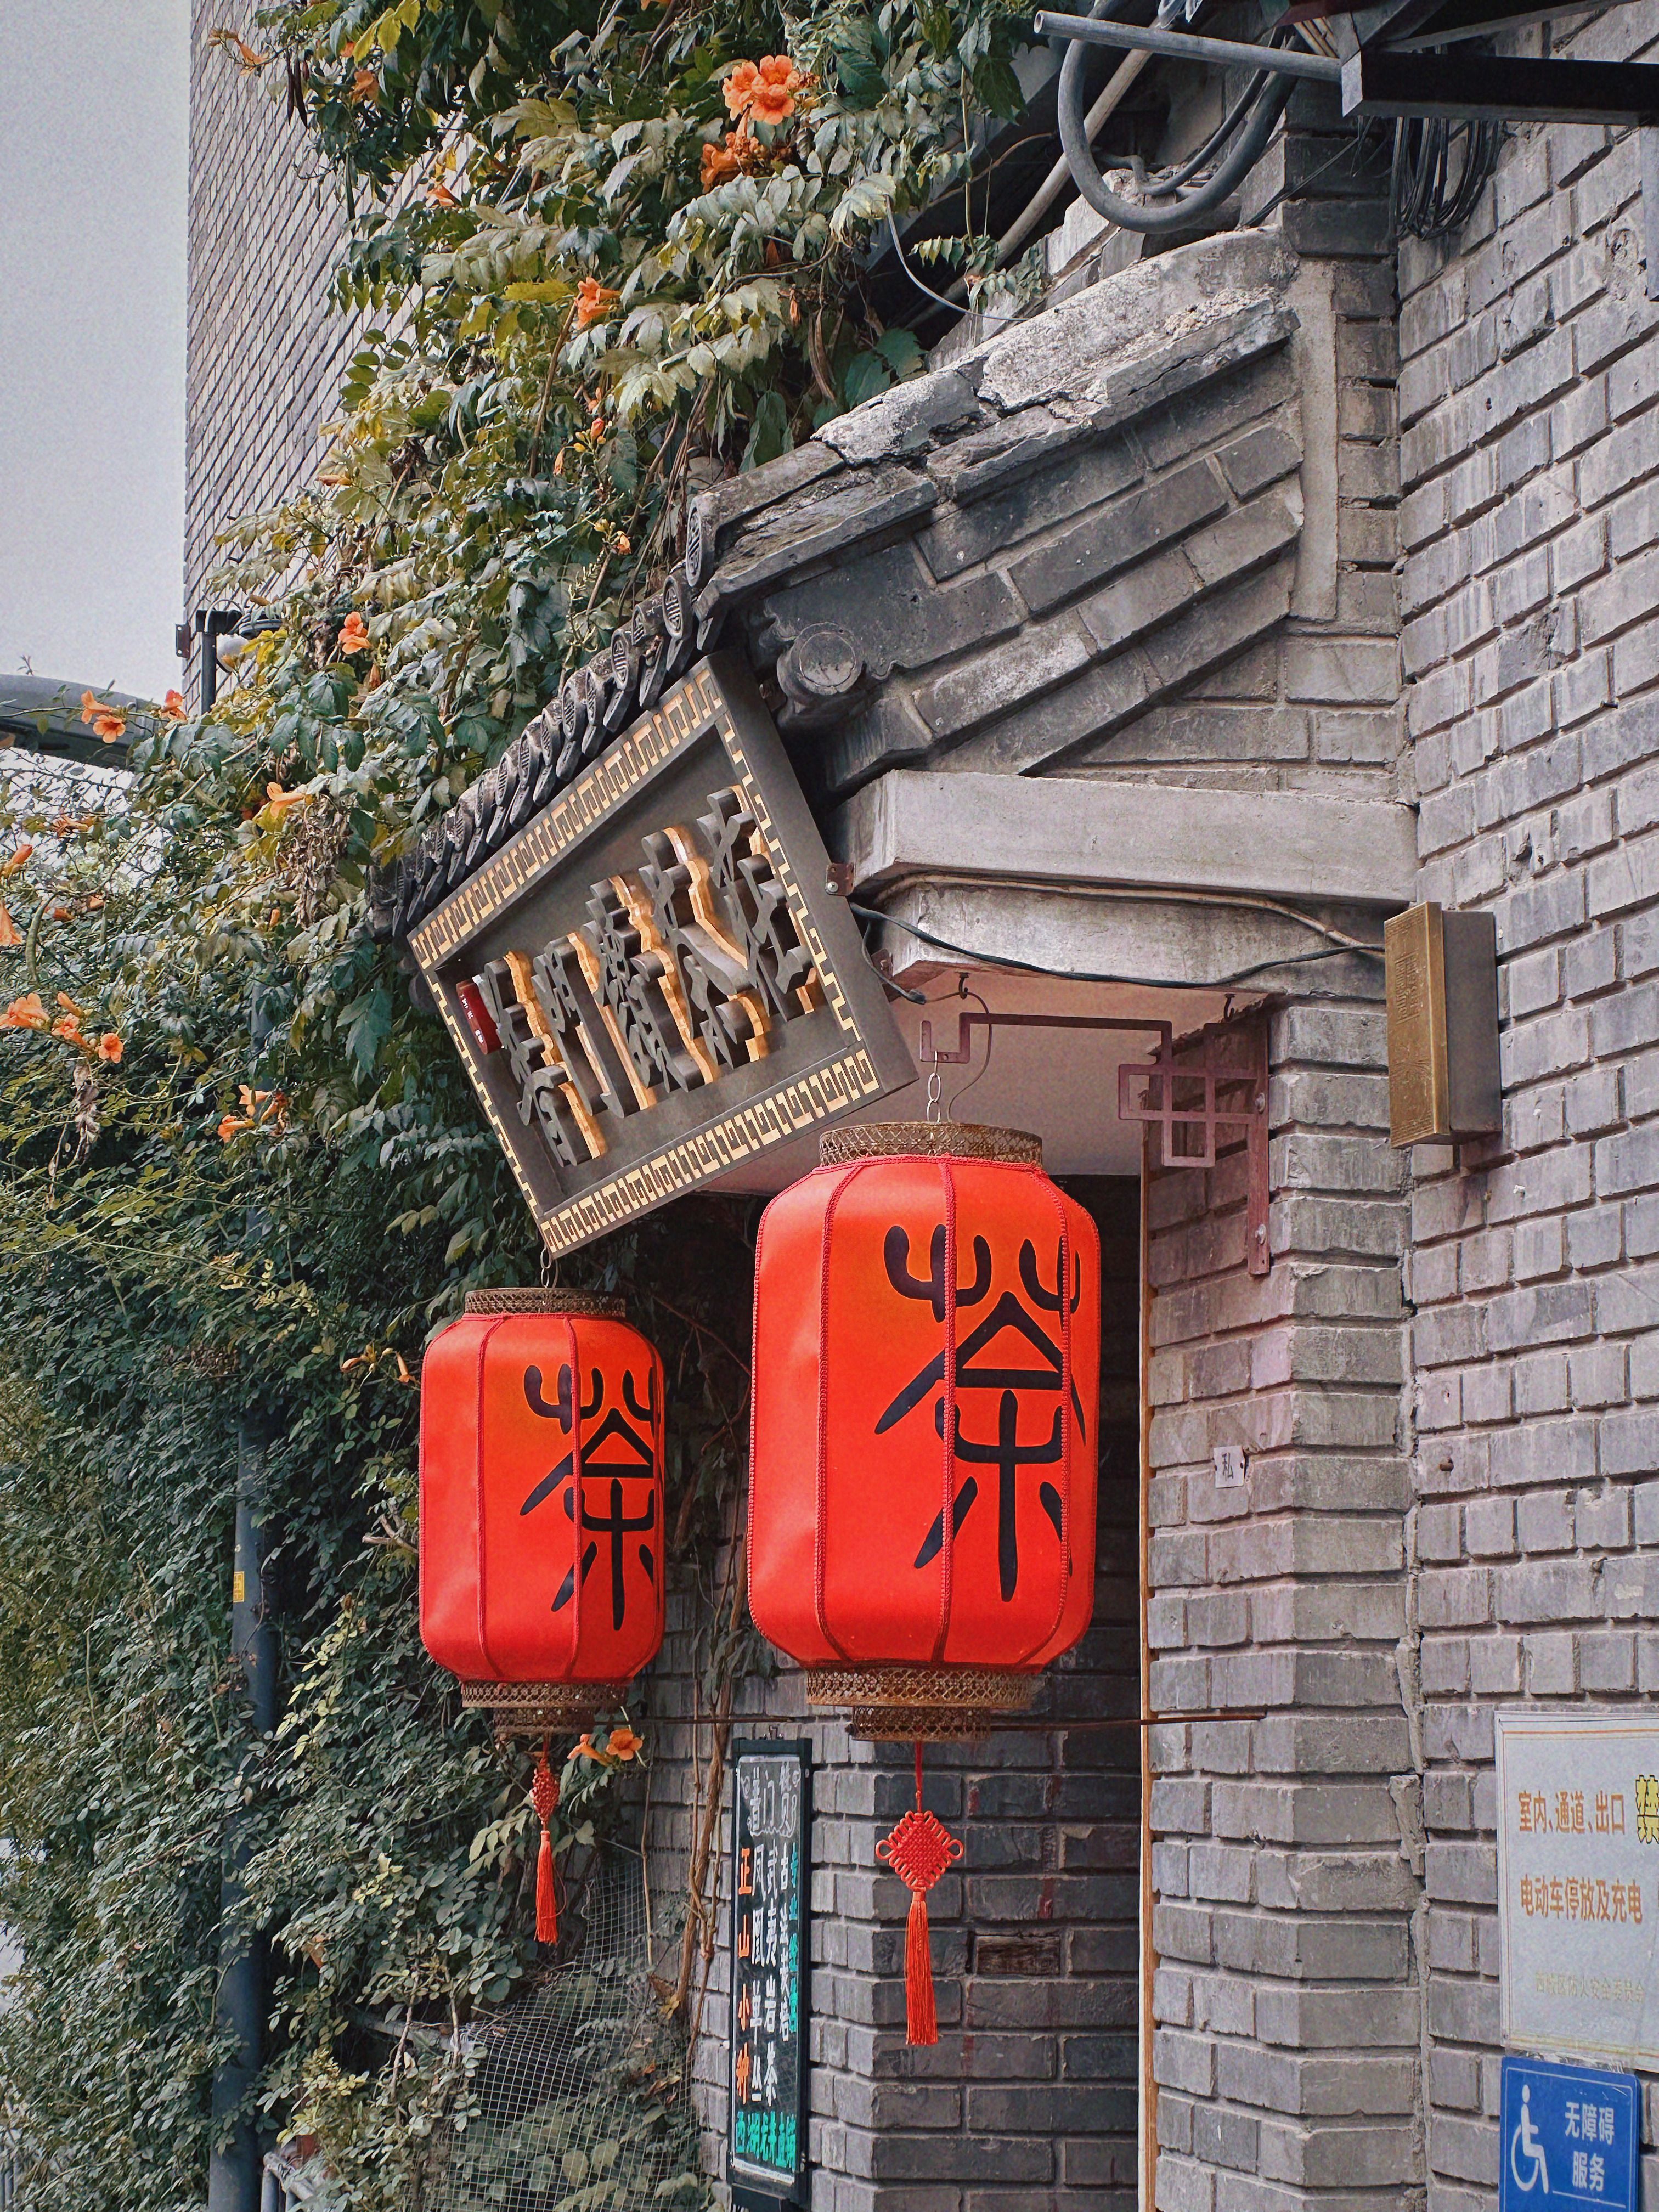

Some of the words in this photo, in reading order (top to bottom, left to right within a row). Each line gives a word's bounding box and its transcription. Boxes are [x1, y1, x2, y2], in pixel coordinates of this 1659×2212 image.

[1518, 1790, 1626, 1835] 室内、通道、出口
[1520, 1873, 1643, 1925] 电动车停放及充电
[736, 1847, 752, 2104] 正山小种
[750, 1843, 766, 2102] 凤凰单丛
[736, 2111, 797, 2172] 西湖龙井直销
[1565, 2101, 1615, 2145] 无障碍
[1571, 2151, 1606, 2192] 服务
